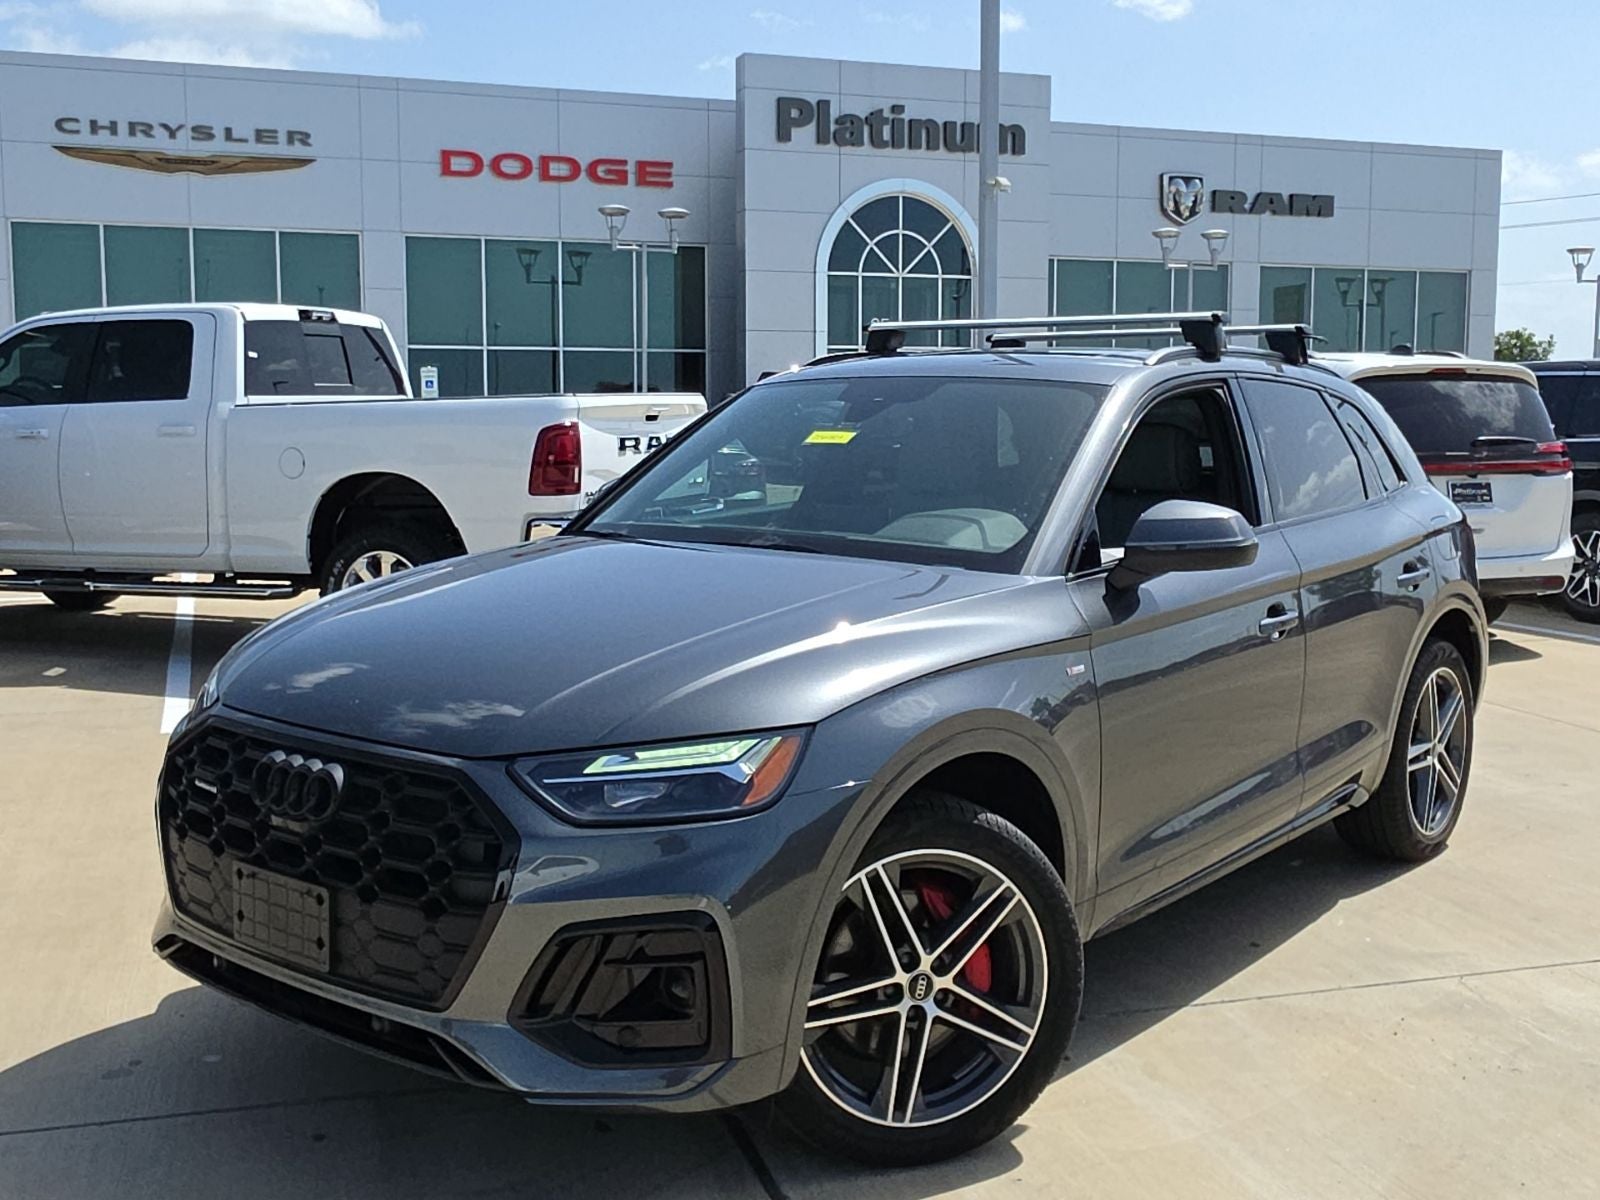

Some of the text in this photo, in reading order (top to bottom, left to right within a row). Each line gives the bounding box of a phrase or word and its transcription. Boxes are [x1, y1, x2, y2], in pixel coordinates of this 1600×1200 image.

[54, 117, 314, 147] CHRYSLER
[776, 96, 1026, 155] Platinum
[440, 149, 674, 188] DODGE
[1211, 189, 1335, 218] RAM
[617, 435, 672, 456] RA
